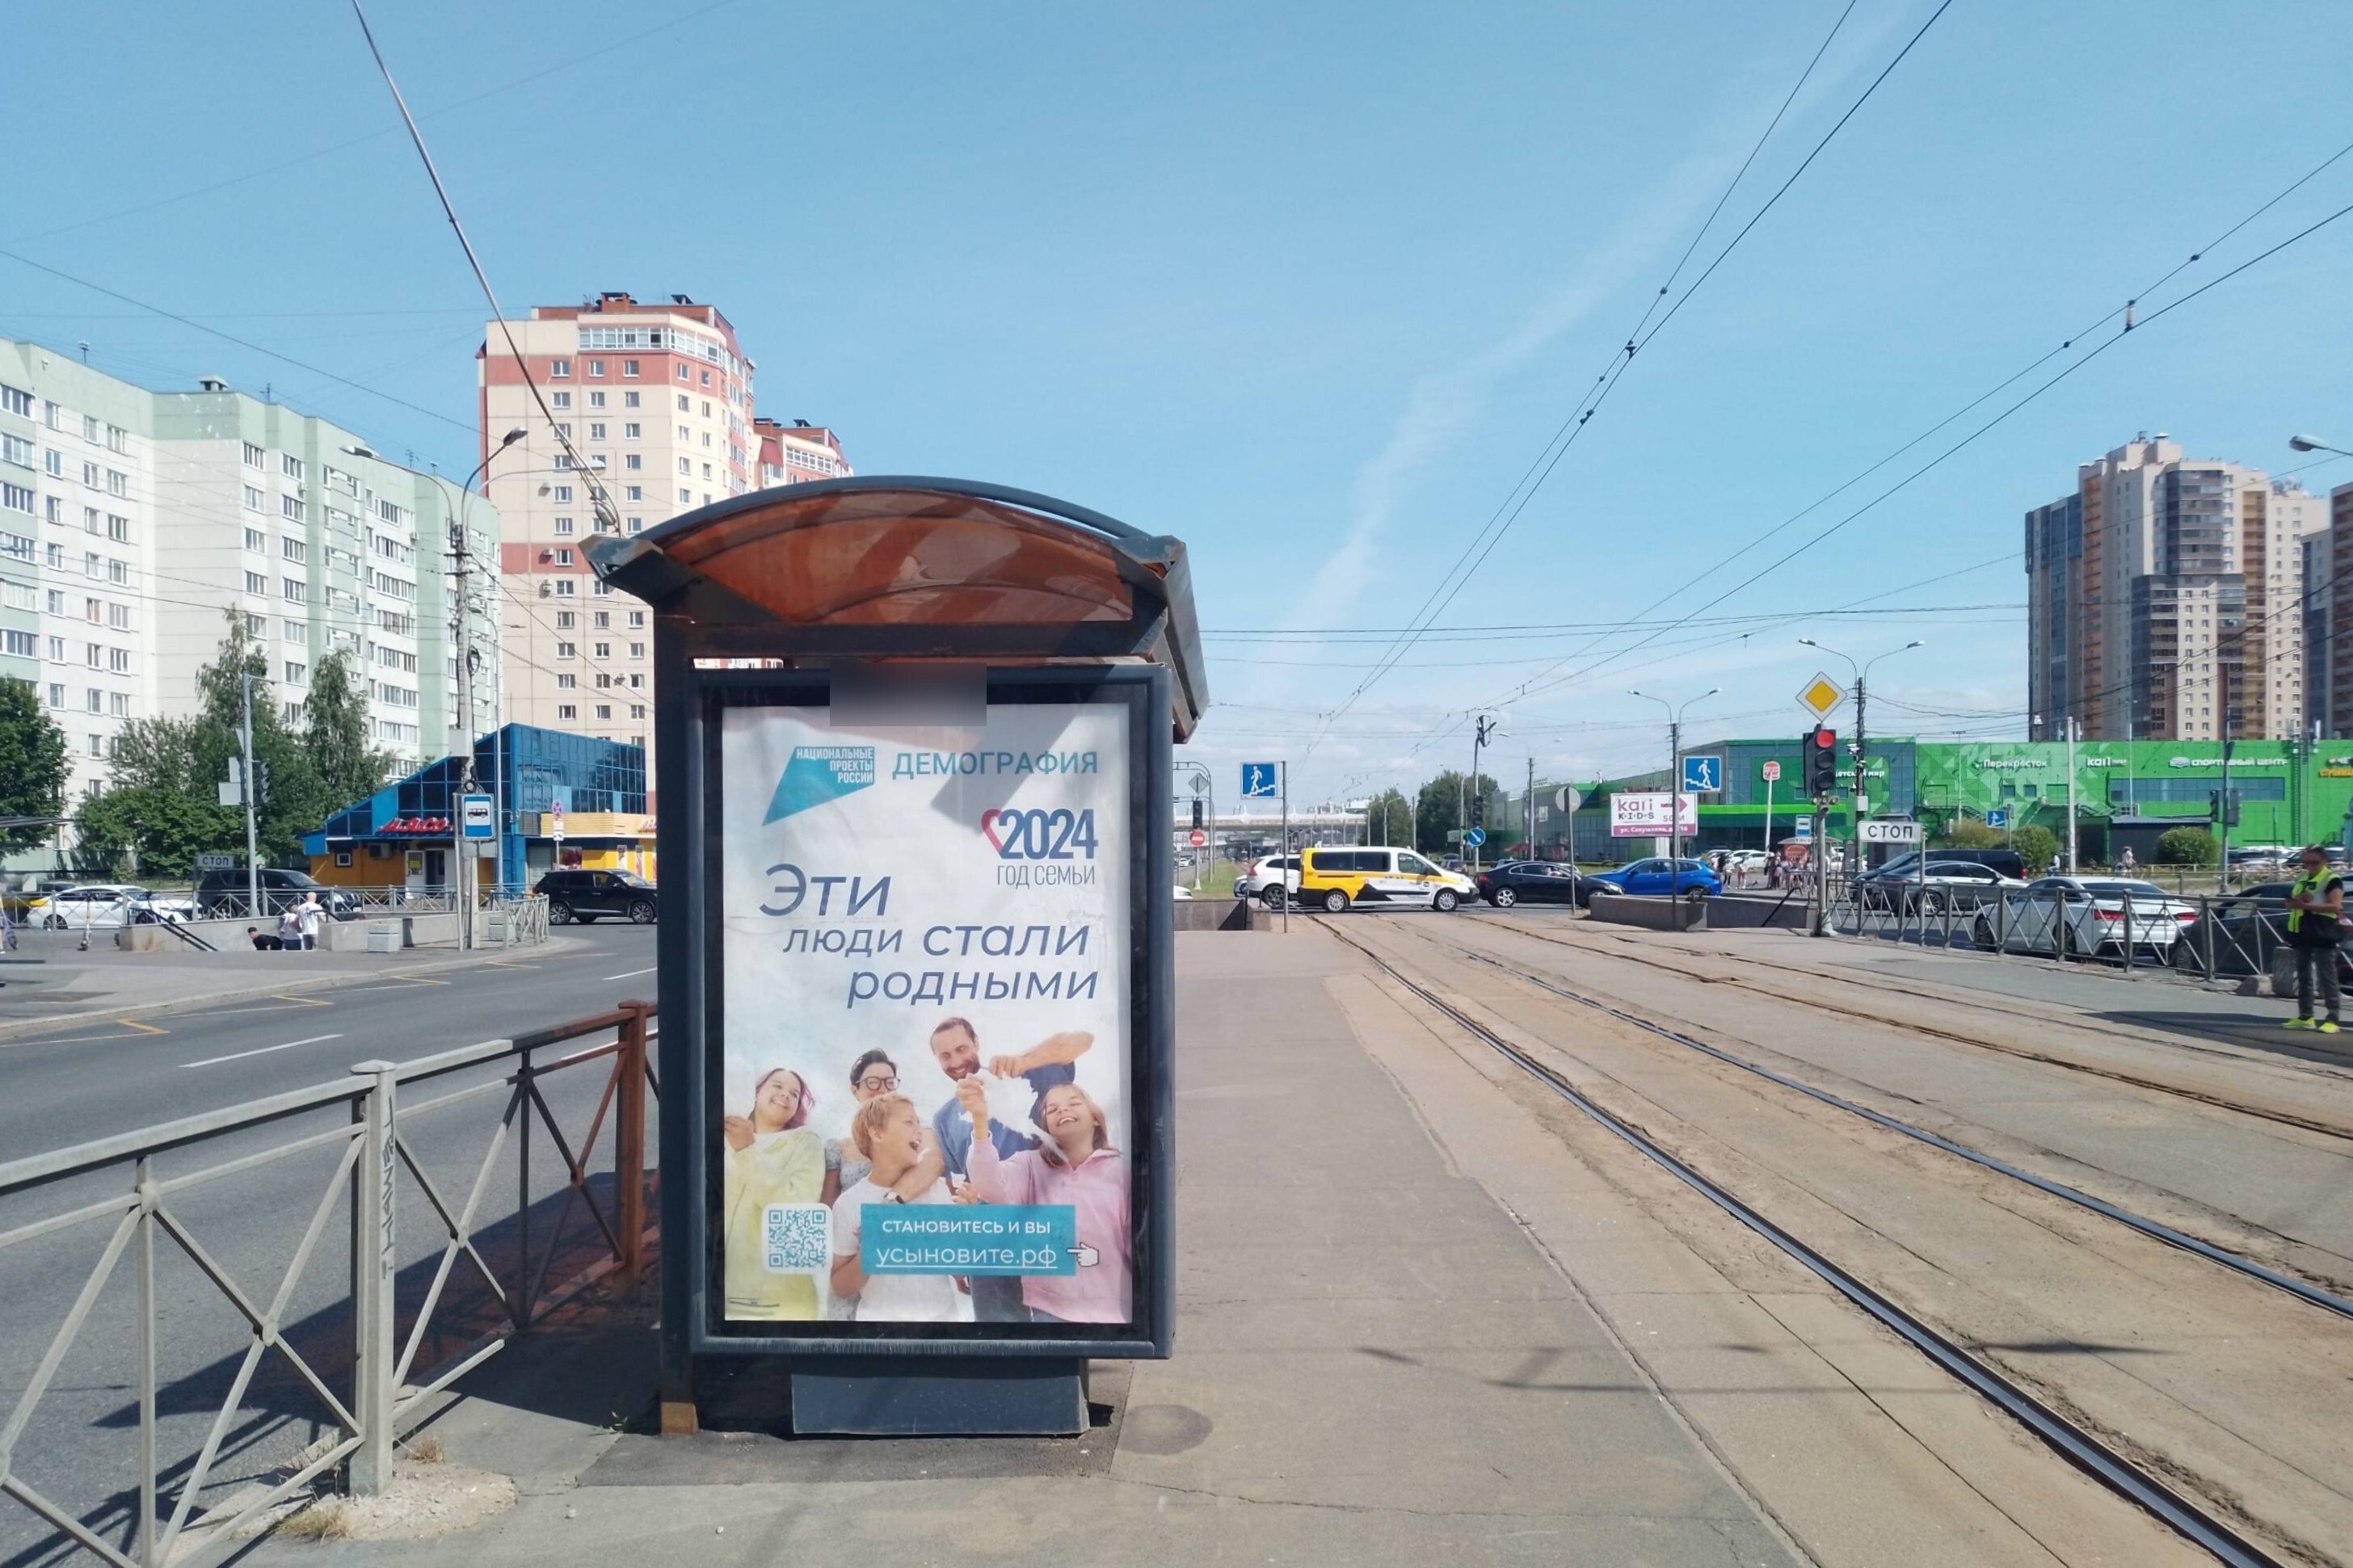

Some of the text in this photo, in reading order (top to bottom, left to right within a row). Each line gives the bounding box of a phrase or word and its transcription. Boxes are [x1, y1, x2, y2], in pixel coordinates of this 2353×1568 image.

[796, 748, 873, 760] НАЦИОНАЛЬНЫЕ
[830, 761, 873, 771] ПРОЕКТЫ
[892, 751, 1098, 780] ДЕМОГРАФИЯ
[837, 772, 873, 784] РОССИИ
[1618, 797, 1653, 812] kari
[999, 808, 1099, 860] 2024
[1868, 825, 1913, 839] СТОП
[202, 856, 229, 866] СТОП
[997, 865, 1029, 889] ГОД
[759, 863, 891, 916] Эти
[782, 925, 1090, 957] люди стали
[847, 971, 1099, 1009] родными
[882, 1220, 1050, 1234] СТАНОВИТЕСЬ И ВЫ
[876, 1244, 1057, 1267] усыновите.рф
